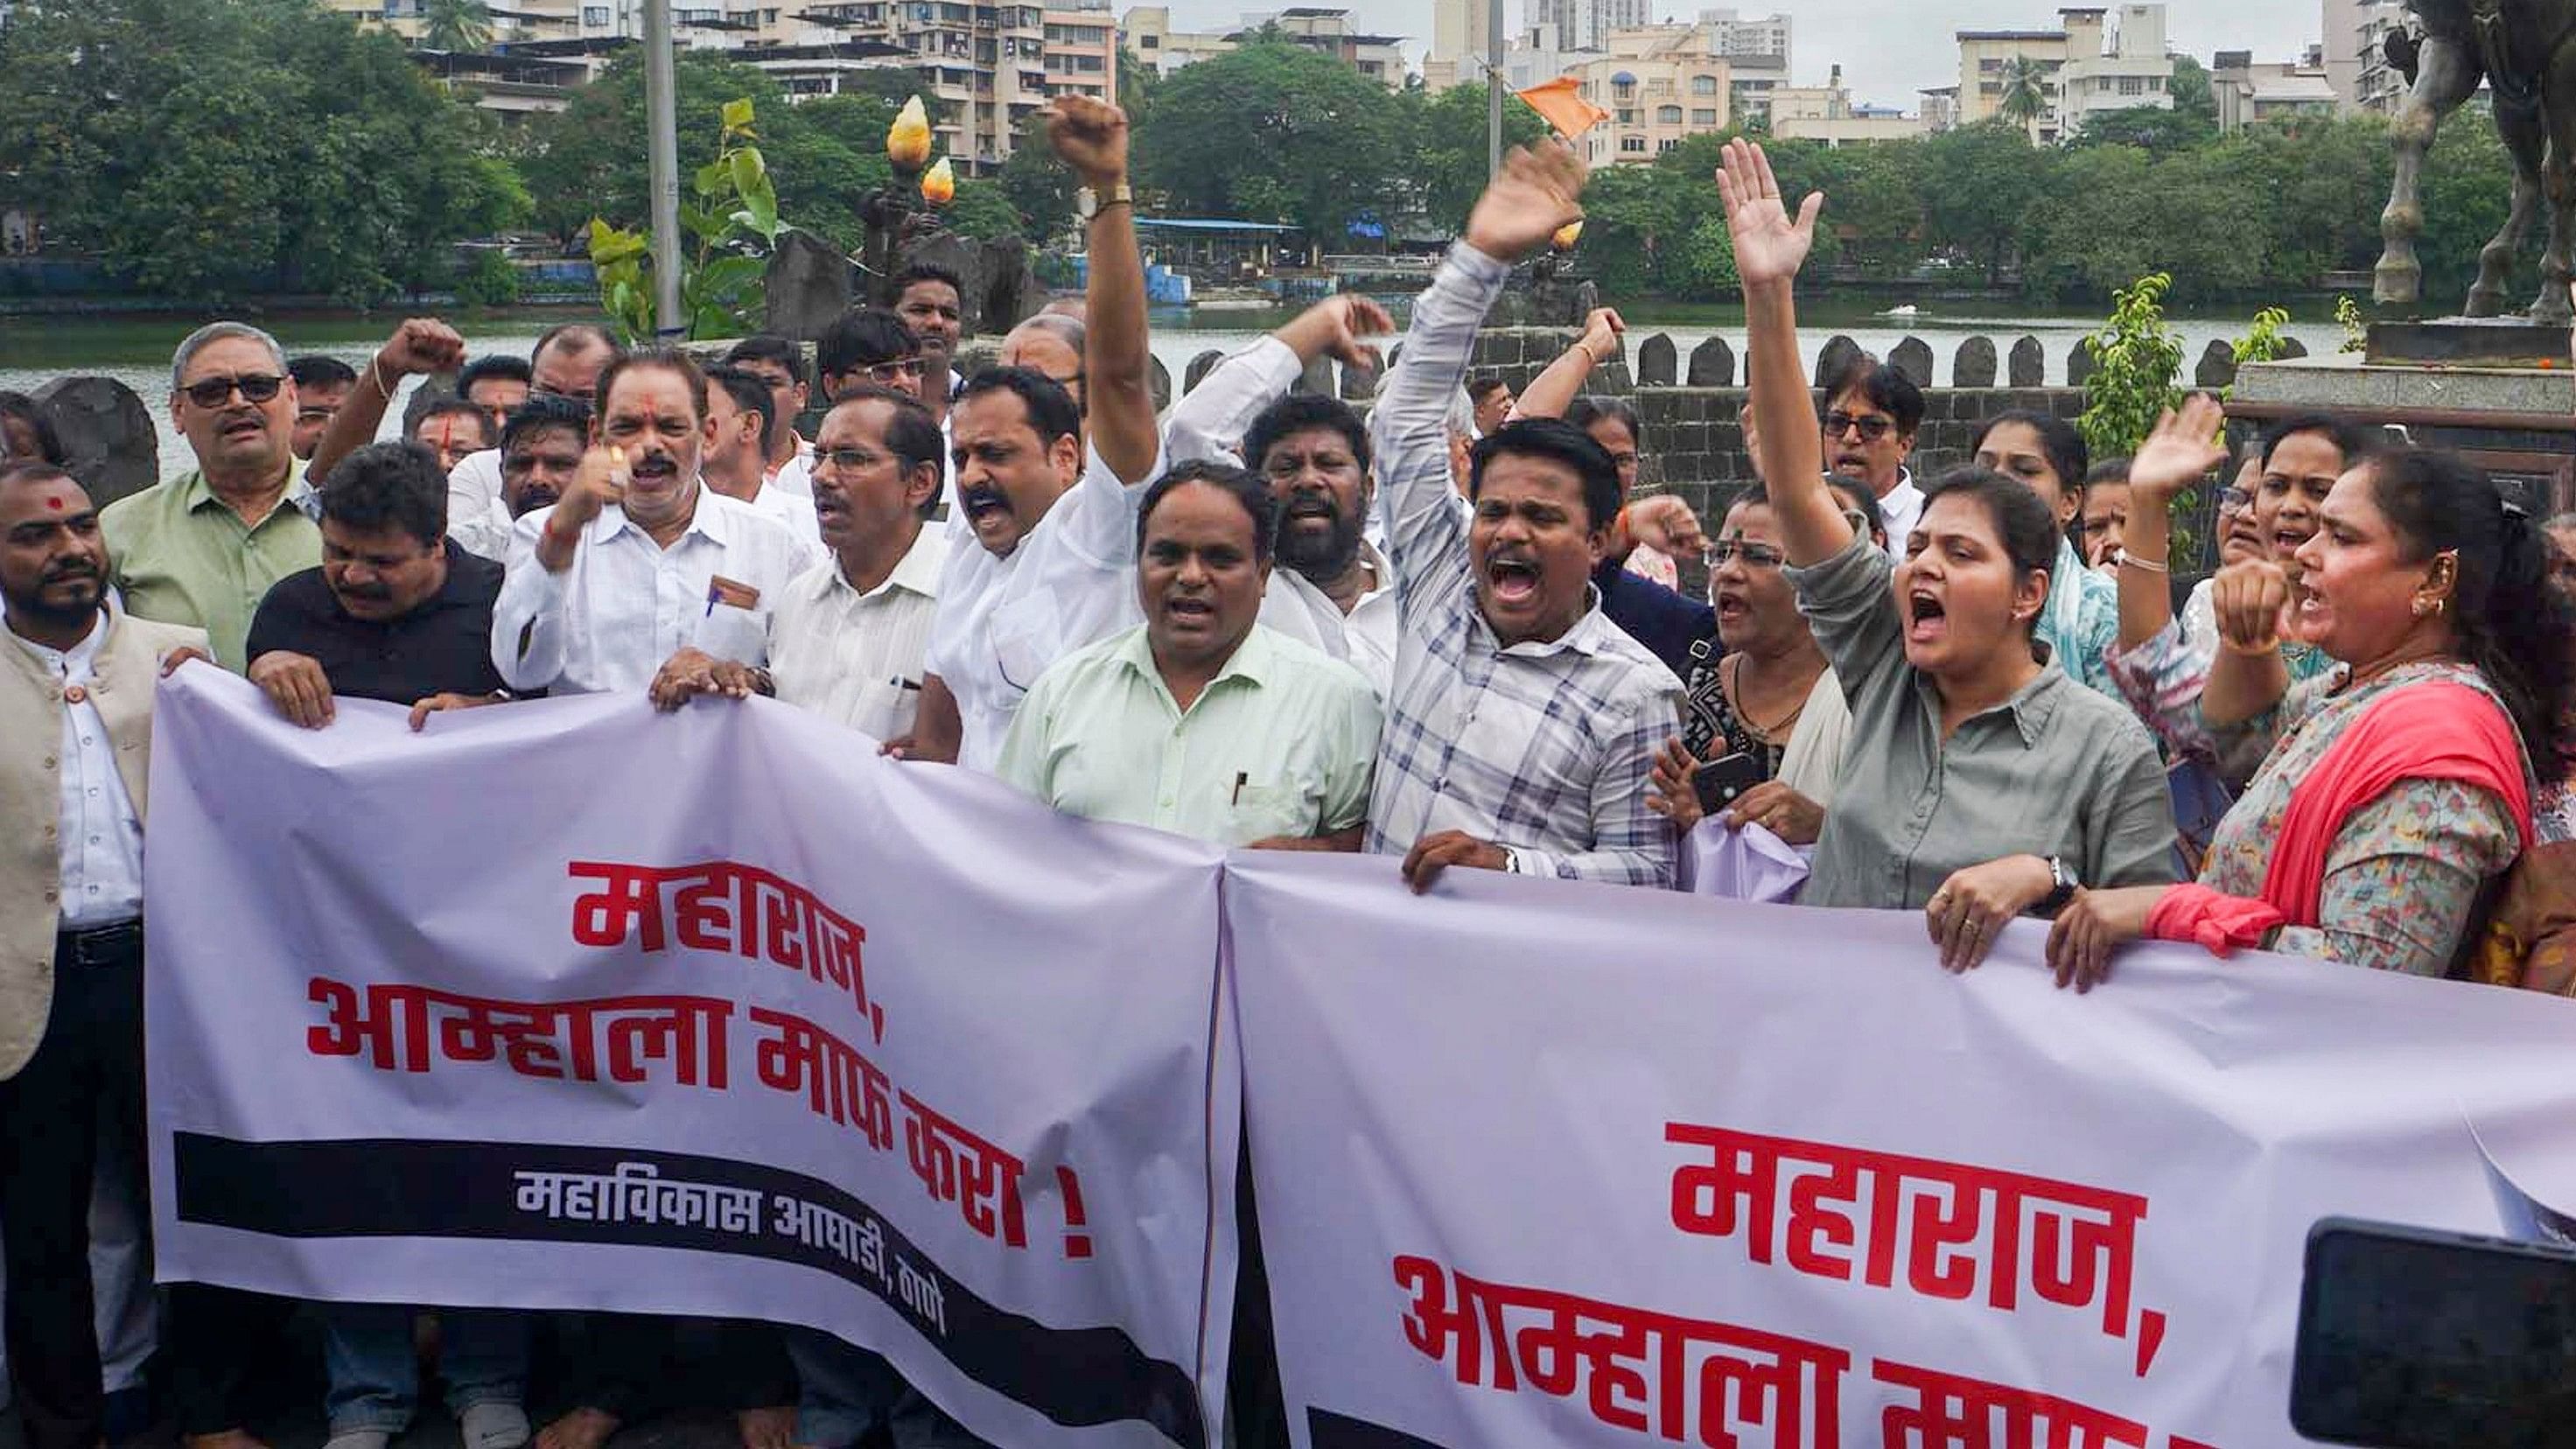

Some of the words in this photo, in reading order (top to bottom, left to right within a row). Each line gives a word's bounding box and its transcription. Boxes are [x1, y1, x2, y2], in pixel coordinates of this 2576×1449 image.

[569, 859, 885, 1046] महाराज,
[308, 977, 732, 1088] आम्हाला
[750, 1006, 894, 1152] माफ
[900, 1088, 1026, 1249] करा
[514, 1162, 764, 1235] महाविकास
[774, 1194, 892, 1295] आघाडी,
[895, 1255, 947, 1337] ठाणे
[1664, 1121, 2166, 1377] महाराज,
[1393, 1255, 1852, 1449] आम्हाला
